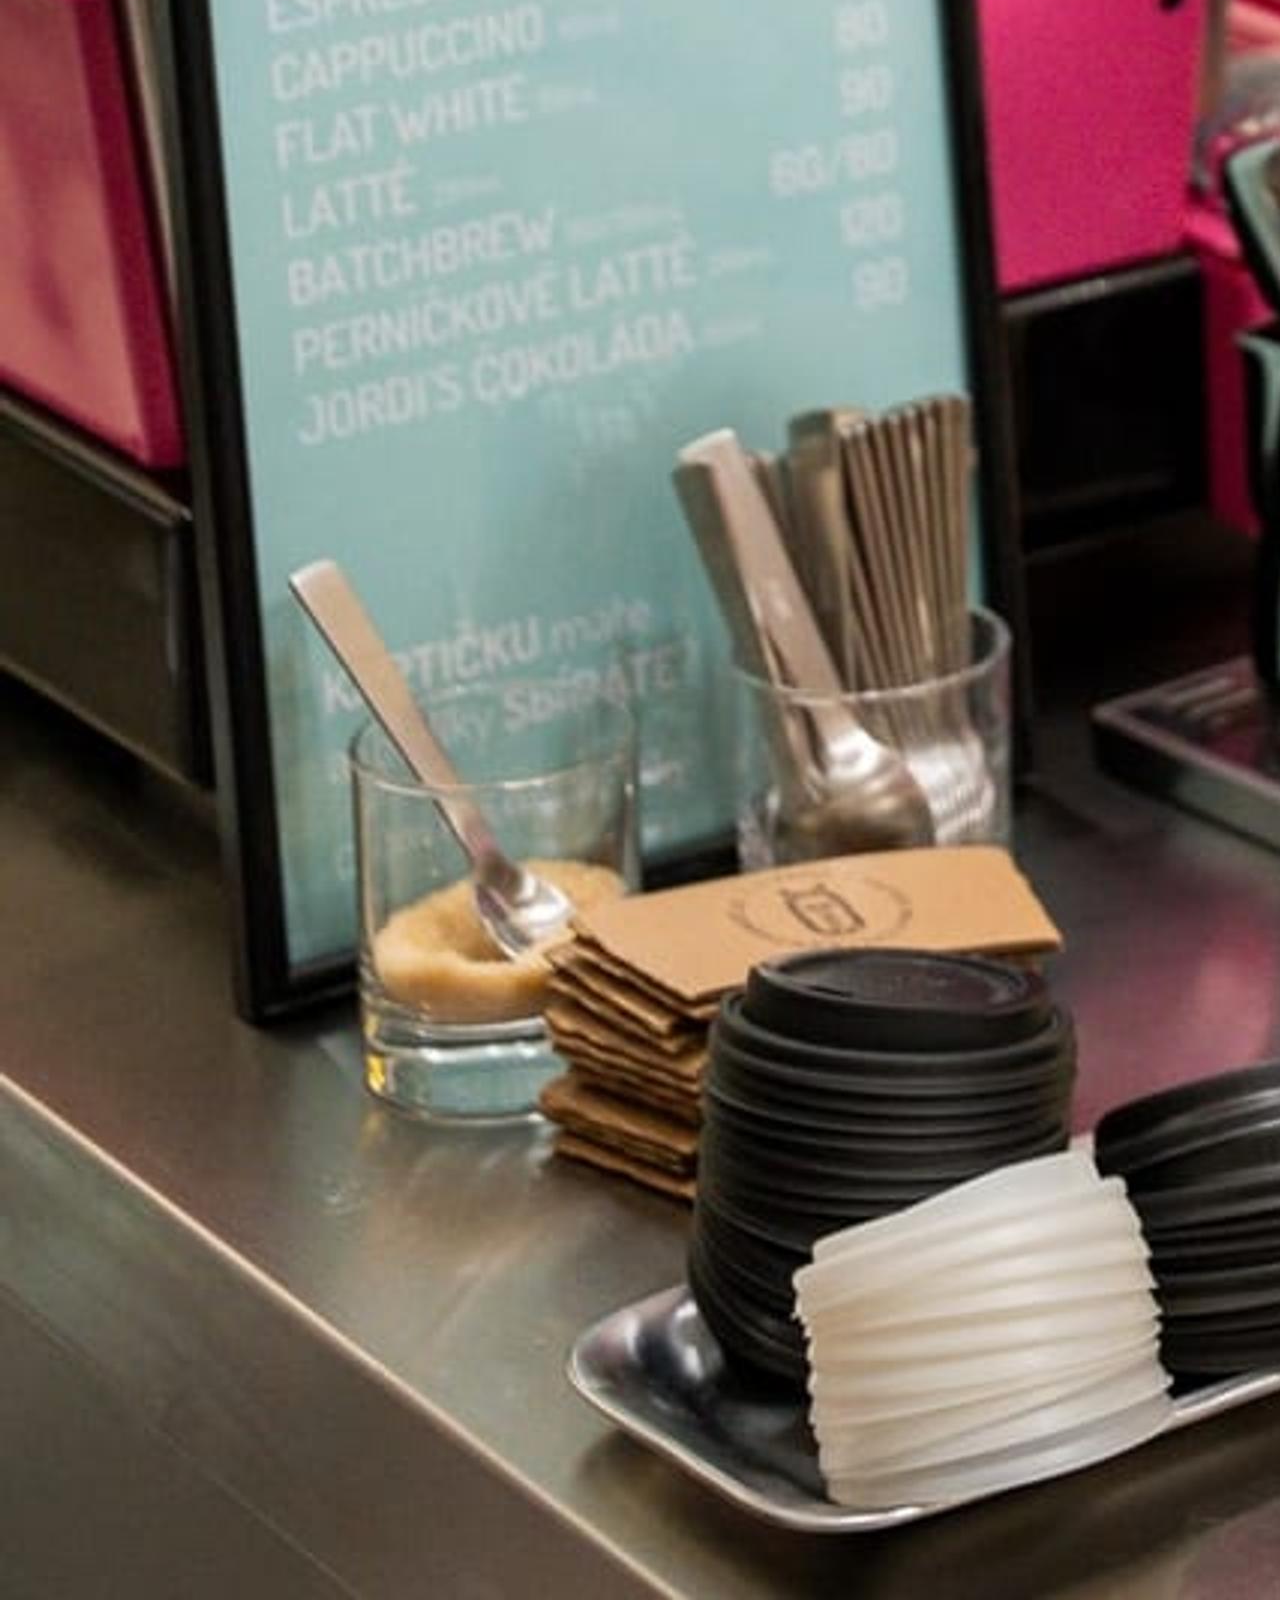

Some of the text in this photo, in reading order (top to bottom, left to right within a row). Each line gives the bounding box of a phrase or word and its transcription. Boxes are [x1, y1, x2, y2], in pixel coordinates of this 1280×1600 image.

[271, 3, 545, 101] CAPPUCCINO
[274, 103, 380, 170] FLAT
[386, 71, 530, 146] WHITE
[287, 207, 557, 307] BATCHBREW
